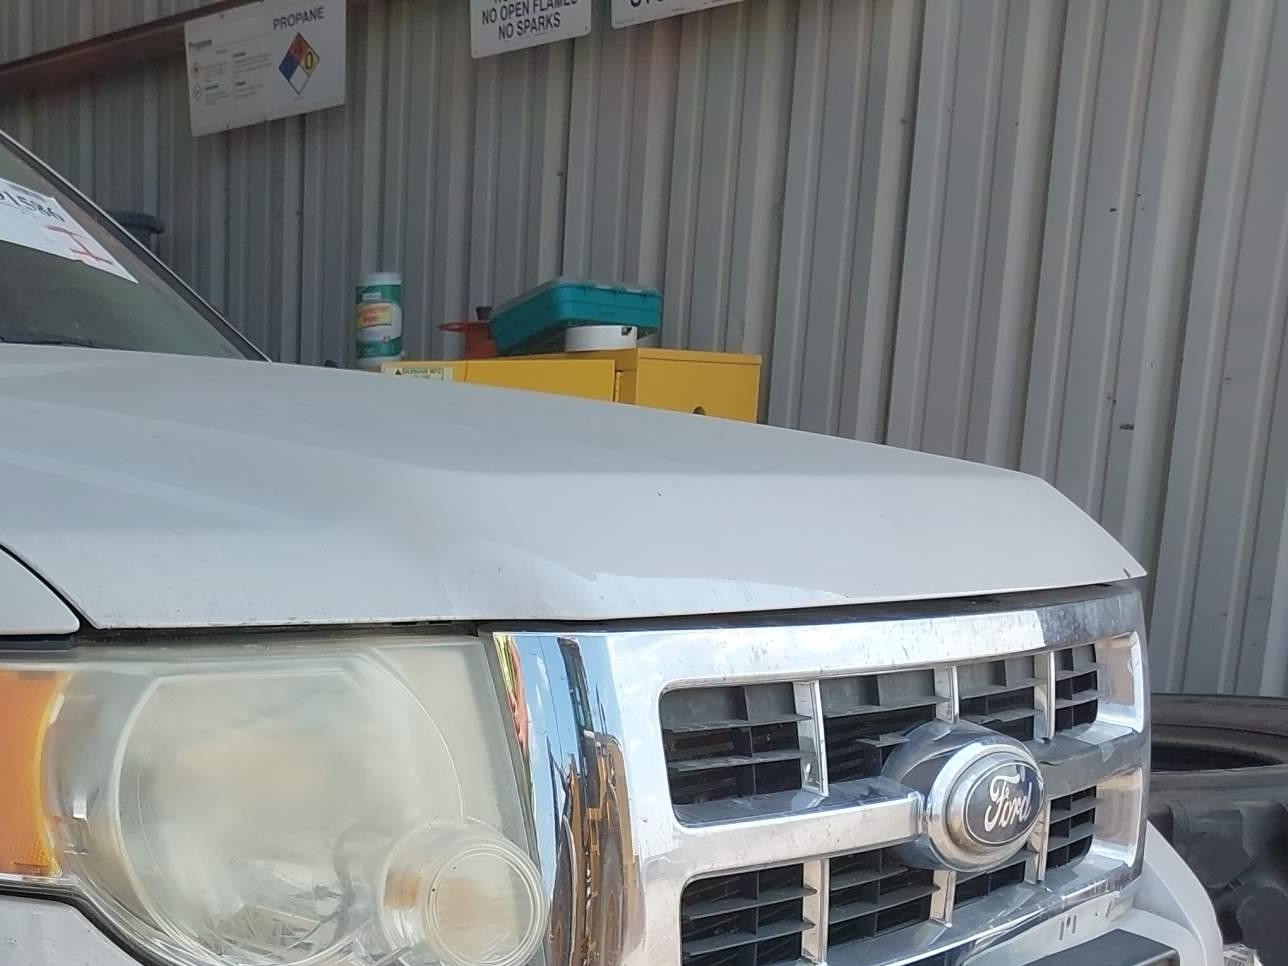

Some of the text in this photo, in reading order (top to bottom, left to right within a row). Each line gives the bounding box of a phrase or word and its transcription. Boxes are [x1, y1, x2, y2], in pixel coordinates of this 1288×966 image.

[272, 6, 325, 31] PROPANE
[482, 7, 497, 24] NO
[500, 0, 529, 21] OPEN
[498, 22, 514, 40] NO
[516, 11, 561, 36] SPARKS
[984, 774, 1033, 832] Ford
